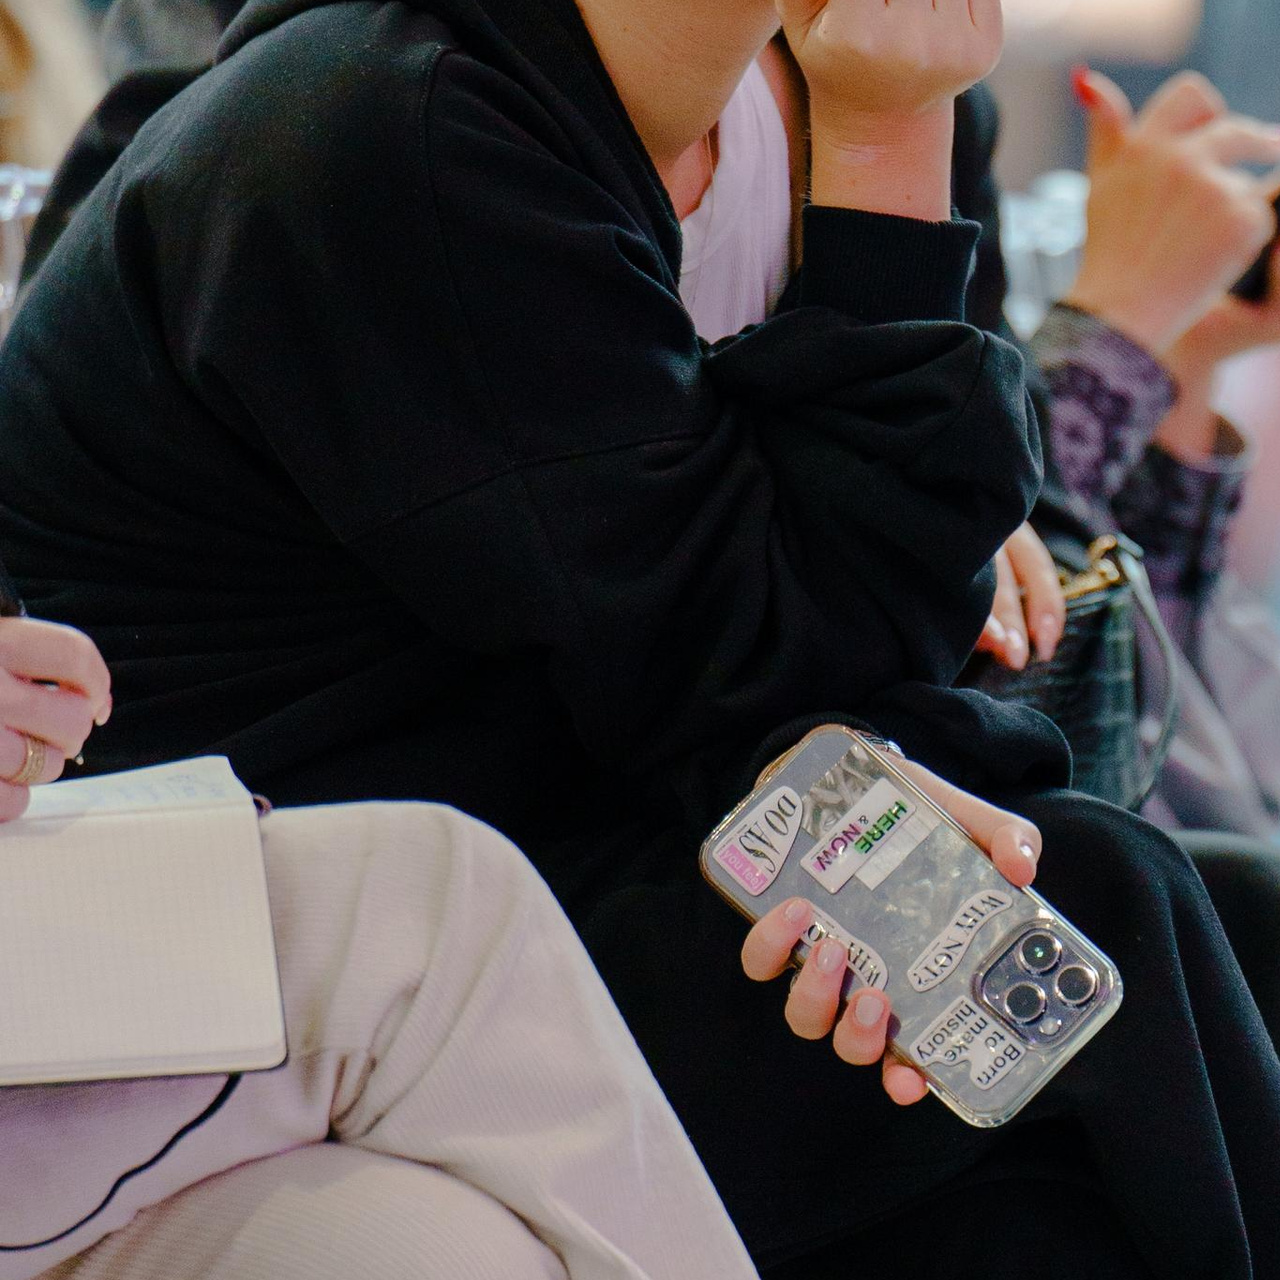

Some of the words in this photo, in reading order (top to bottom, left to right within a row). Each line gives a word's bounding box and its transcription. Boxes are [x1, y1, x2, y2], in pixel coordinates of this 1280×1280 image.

[764, 794, 797, 836] DO
[854, 800, 908, 854] HERE
[858, 815, 869, 825] &
[721, 848, 743, 871] you
[741, 865, 765, 891] feel
[739, 821, 780, 874] AS
[814, 823, 862, 872] NOW
[955, 895, 1005, 936] WHY
[913, 936, 965, 986] NOT?
[916, 1003, 977, 1060] history
[944, 1017, 989, 1062] make
[984, 1030, 1006, 1050] to
[977, 1043, 1021, 1085] Born
